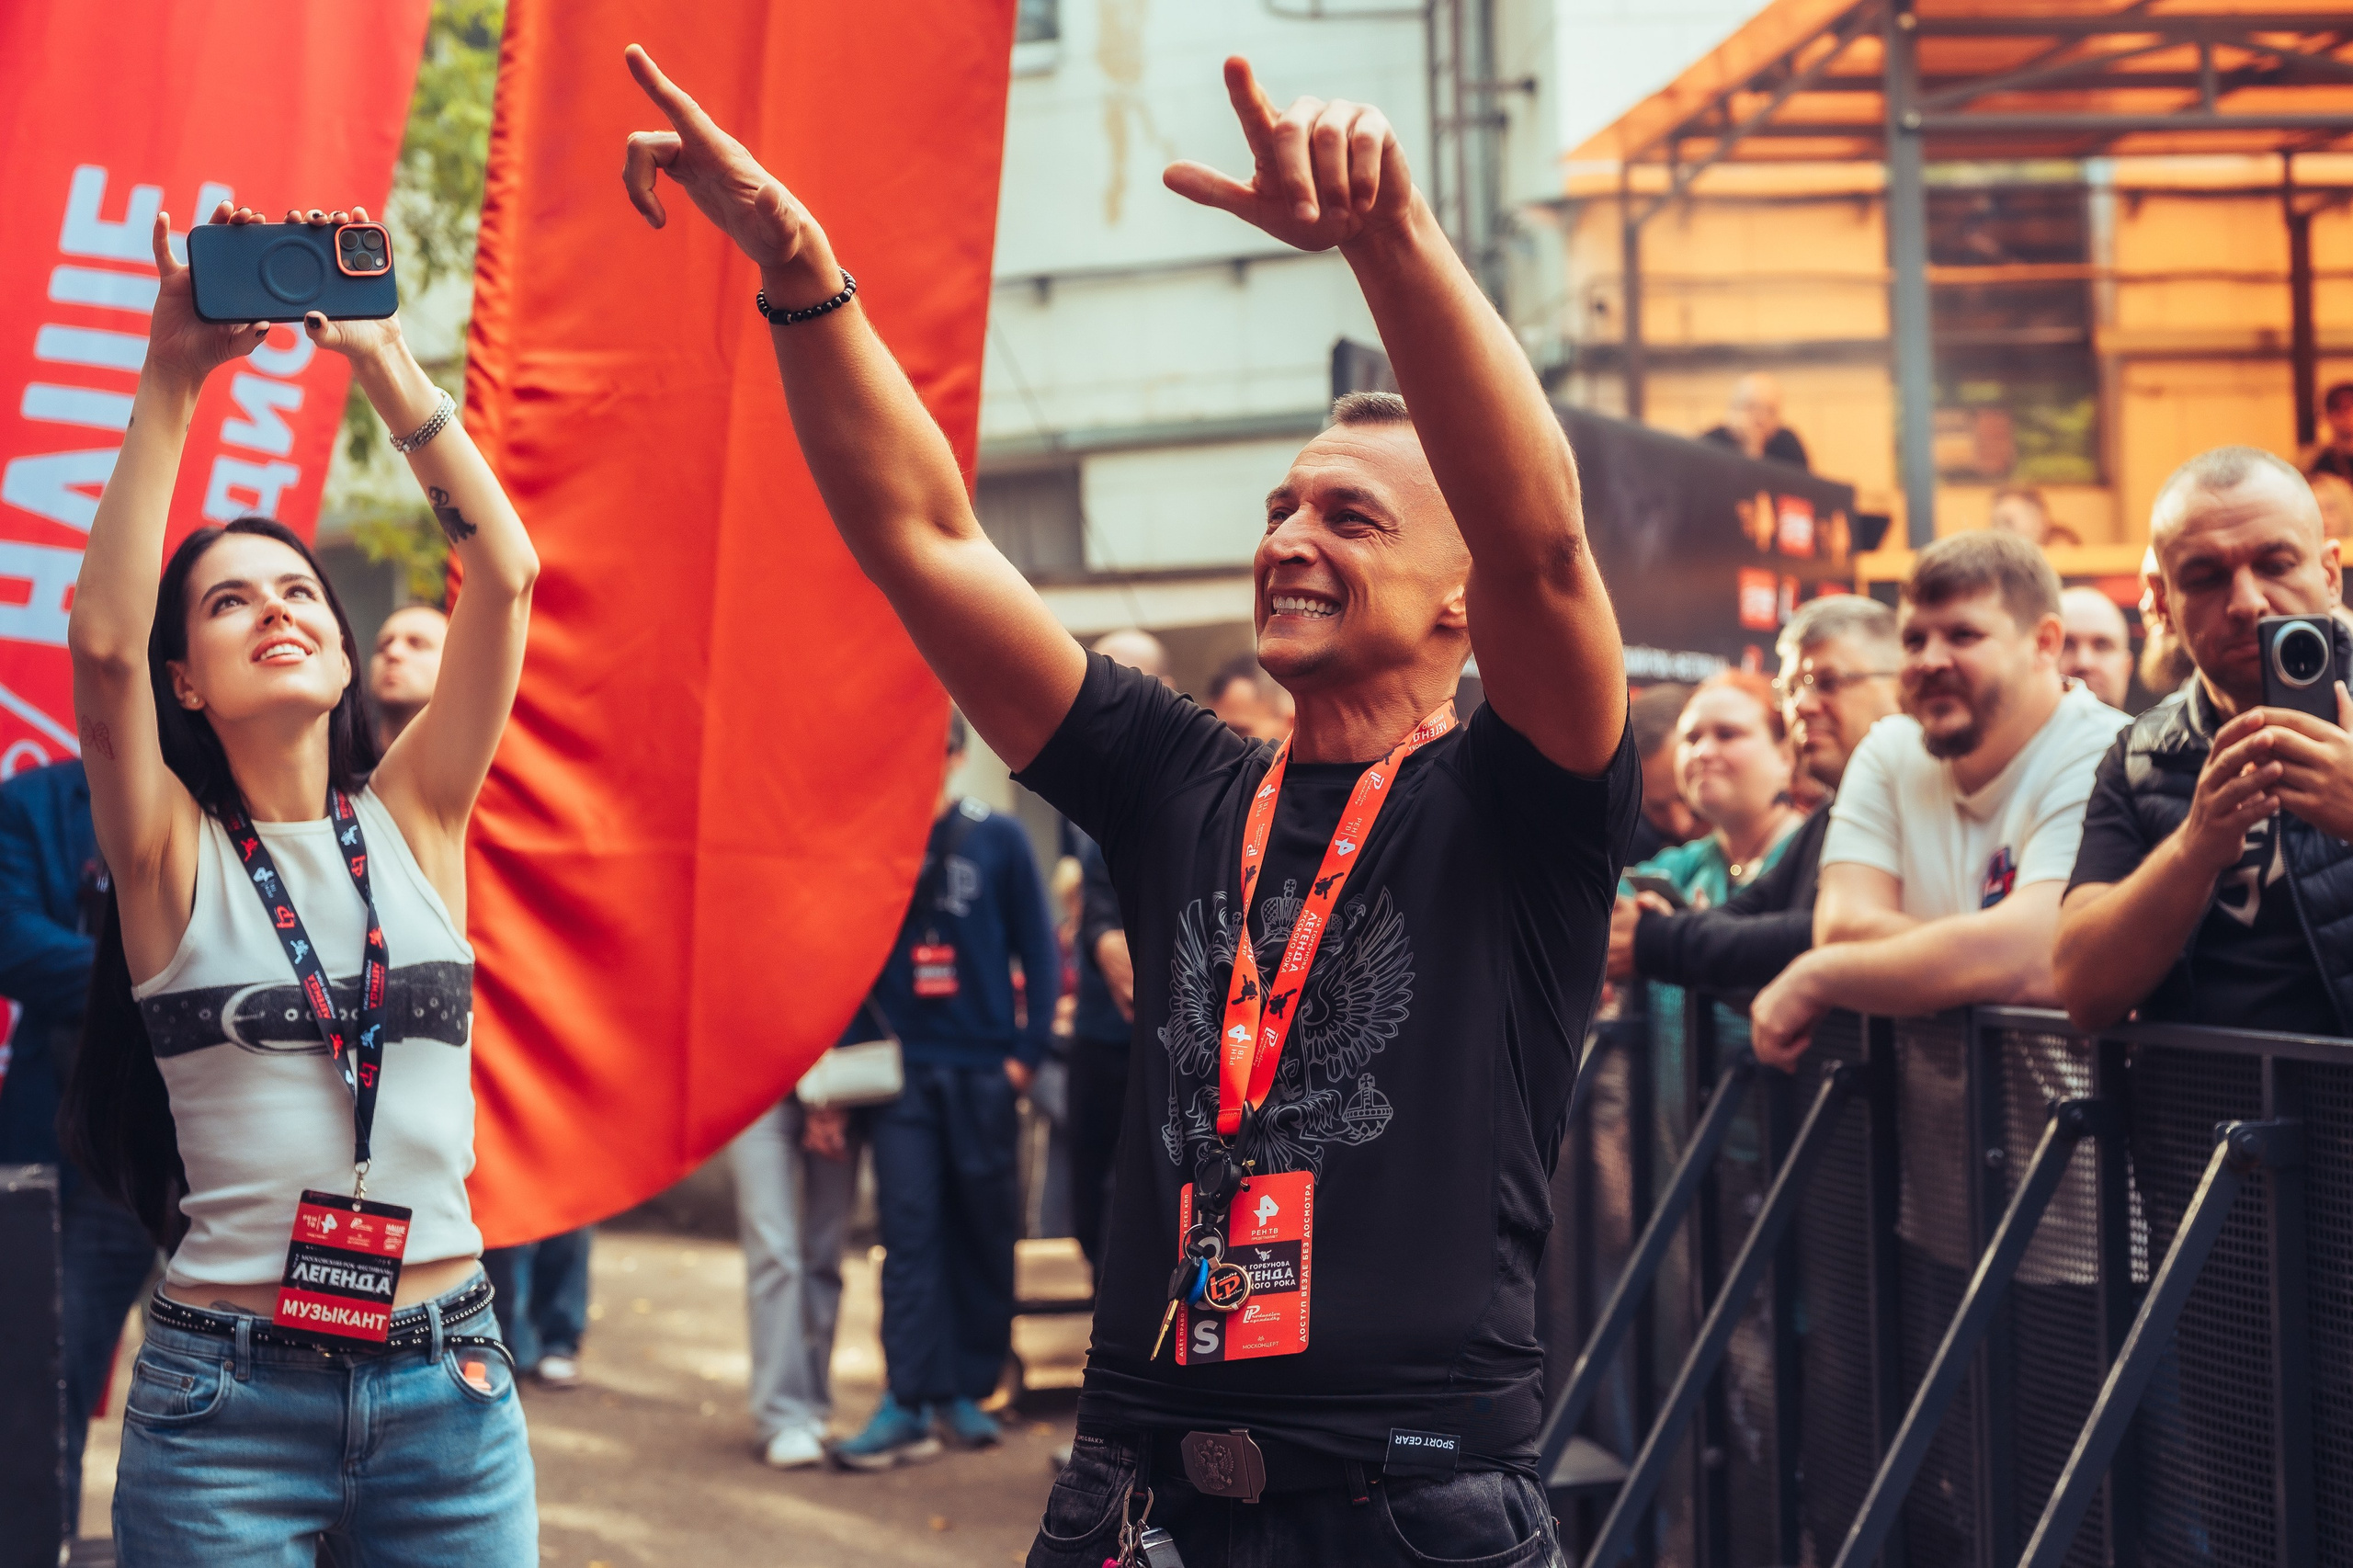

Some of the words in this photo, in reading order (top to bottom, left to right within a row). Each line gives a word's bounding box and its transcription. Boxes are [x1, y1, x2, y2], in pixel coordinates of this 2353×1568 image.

[1413, 720, 1448, 743] ЛЕГЕНД
[1345, 822, 1354, 831] ТВ
[1351, 817, 1362, 834] РЕН
[1290, 909, 1310, 949] РУССКОГО
[1289, 912, 1318, 972] ЛЕГЕНДА
[1300, 930, 1318, 971] ГОРБУНОВА
[1280, 951, 1293, 973] РОКА
[1229, 1049, 1237, 1065] РЕН
[1237, 1050, 1245, 1060] ТВ
[1249, 1260, 1290, 1270] ГОРБУНОВА
[290, 1262, 392, 1296] ЛЕГЕНДА
[1248, 1267, 1294, 1281] ГЕНДА
[1274, 1278, 1296, 1287] РОКА
[282, 1299, 387, 1331] МУЗЫКАНТ
[1299, 1301, 1307, 1343] ДОСТУП
[1242, 1341, 1279, 1349] МОСКОНЦЕРТ
[1394, 1435, 1422, 1446] GEAR
[1423, 1437, 1455, 1449] SPORT
